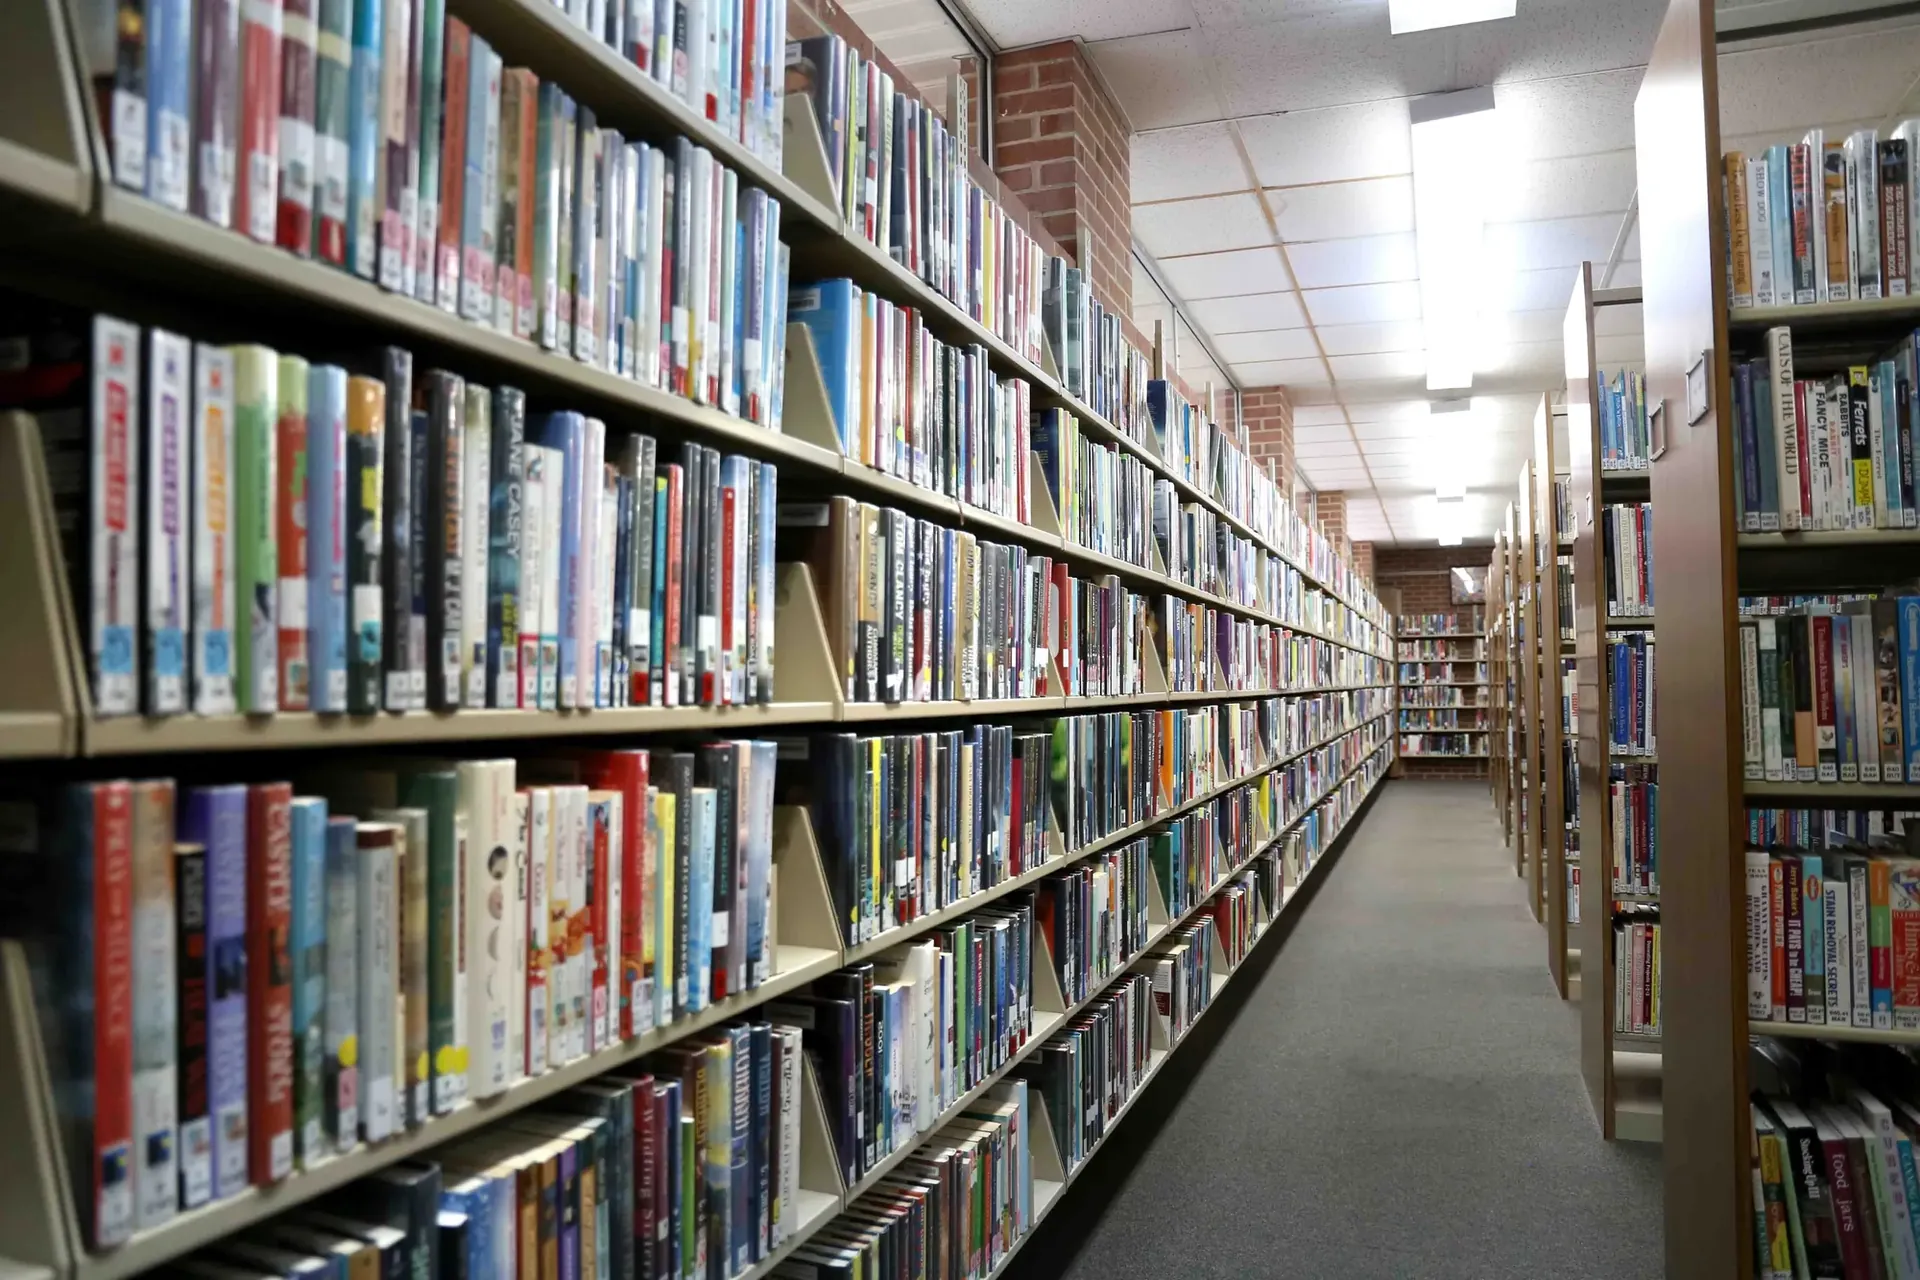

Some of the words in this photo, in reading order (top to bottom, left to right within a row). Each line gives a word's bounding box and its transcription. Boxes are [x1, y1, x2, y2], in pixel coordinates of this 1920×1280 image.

[1756, 166, 1765, 197] SHOW
[1885, 186, 1894, 202] DOG
[1896, 184, 1904, 200] THE
[1757, 201, 1766, 222] DOG
[1886, 205, 1895, 252] REFERENCE
[1896, 201, 1905, 238] ULTIMATE
[1887, 254, 1896, 276] BOOK
[1898, 240, 1906, 275] HUNTING
[1779, 333, 1792, 367] CATS
[1781, 370, 1793, 386] OF
[1782, 393, 1794, 420] THE
[1816, 392, 1827, 431] FANCY
[1840, 393, 1849, 436] RABBITS
[1853, 400, 1868, 445] Ferrets
[508, 414, 521, 476] JANE
[1784, 423, 1797, 474] WORLD
[1818, 438, 1829, 468] MICE
[1904, 463, 1912, 486] DAIRY
[508, 482, 521, 559] CASEY
[641, 516, 652, 570] CASH
[895, 523, 904, 555] TOM
[895, 560, 904, 620] CLANCY
[1818, 627, 1826, 664] Traditional
[1636, 660, 1644, 690] HERITAGE
[1819, 665, 1827, 690] Kitchen
[1636, 700, 1645, 724] QUILTS
[1821, 692, 1829, 720] Wisdom
[106, 818, 127, 883] PRAY
[267, 804, 285, 912] CASTLE
[720, 838, 728, 896] MARRIAGE
[681, 855, 689, 919] MICHAEL
[1790, 866, 1798, 885] Jerry
[1774, 883, 1783, 913] PANTRY
[1790, 887, 1799, 916] Baker's
[1825, 890, 1836, 918] STAIN
[1775, 915, 1784, 947] POWER
[1789, 928, 1801, 949] PAYS
[1826, 920, 1837, 964] REMOVAL
[1904, 921, 1920, 959] Hints
[1790, 968, 1803, 996] CHEAP!
[1828, 967, 1838, 1007] SECRETS
[1903, 975, 1920, 1004] Tips
[268, 1004, 285, 1103] STORM
[1800, 1138, 1814, 1174] Stocking
[1808, 1186, 1820, 1199] III
[1831, 1153, 1850, 1189] food
[1902, 1153, 1917, 1200] CANNING
[1836, 1198, 1854, 1232] jars
